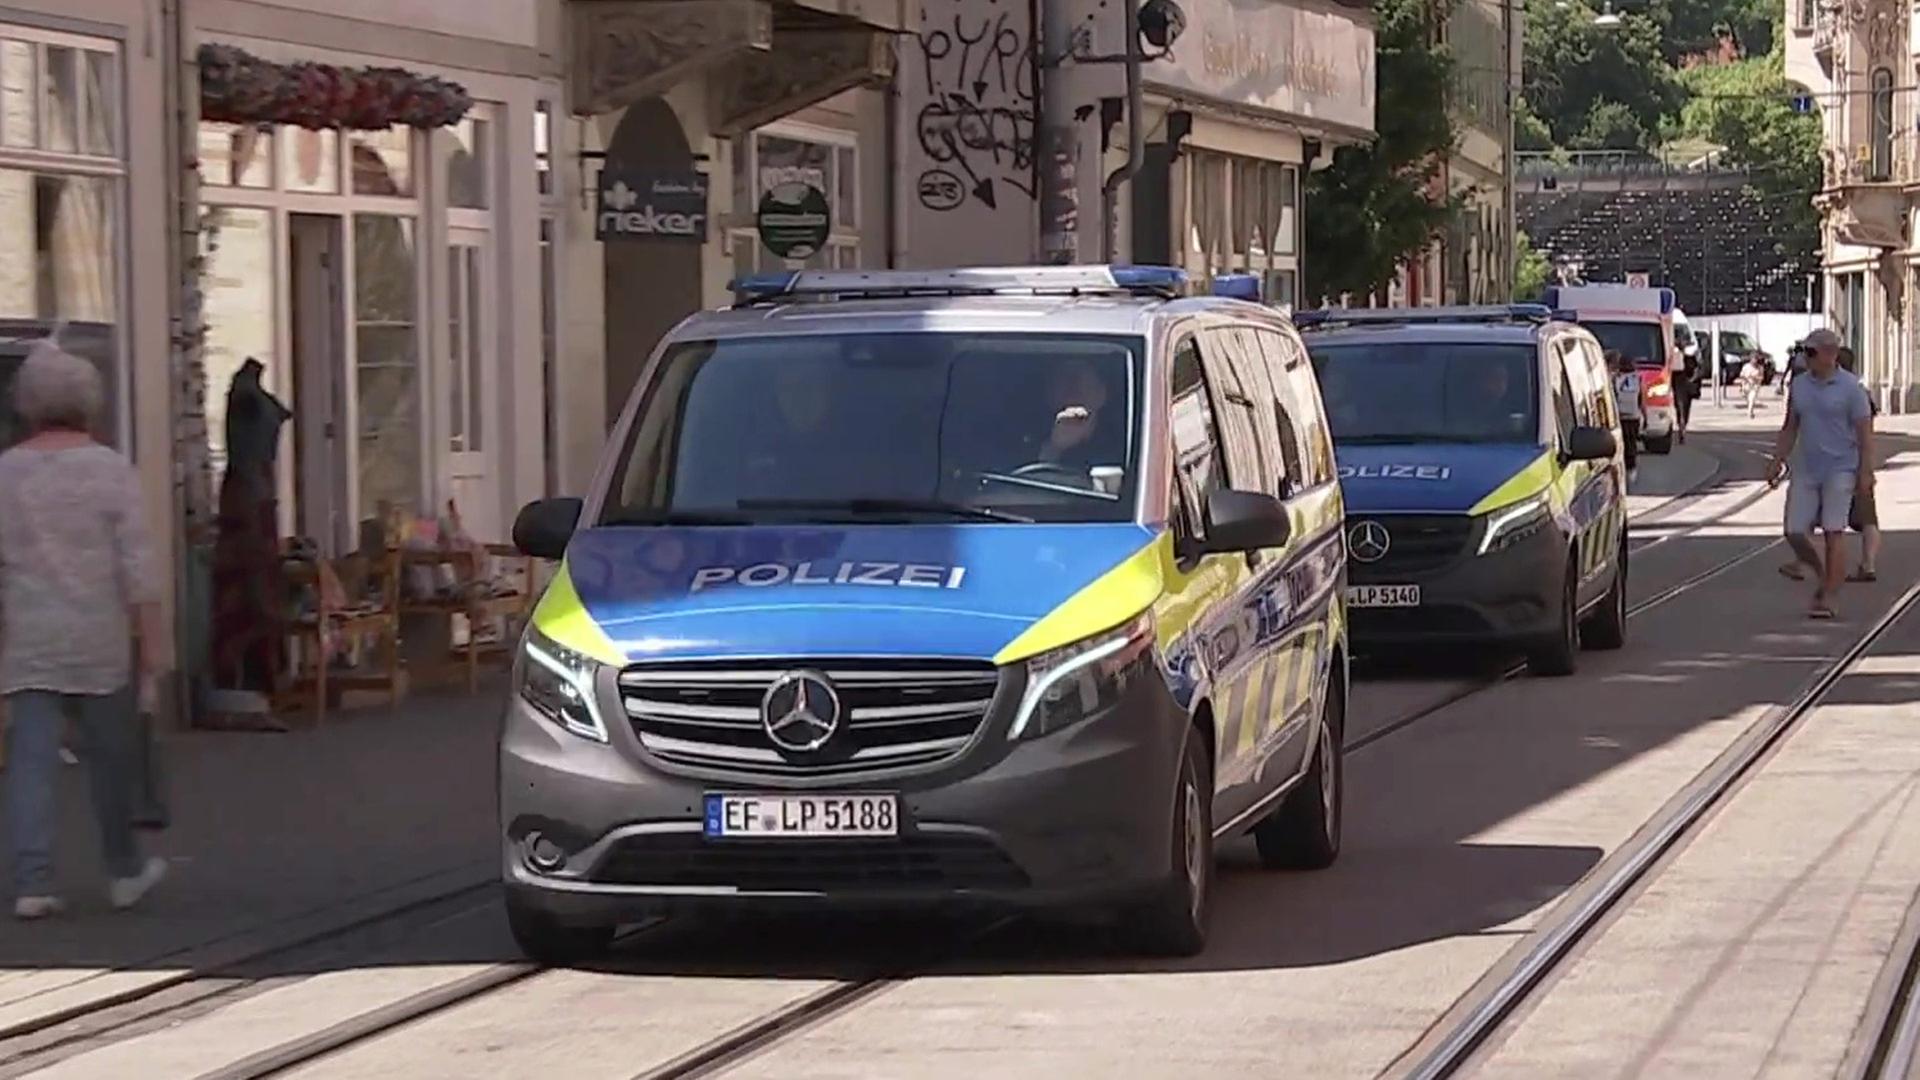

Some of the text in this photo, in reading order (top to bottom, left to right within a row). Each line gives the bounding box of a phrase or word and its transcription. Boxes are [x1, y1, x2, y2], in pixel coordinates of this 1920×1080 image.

[600, 204, 705, 234] rieker
[1339, 464, 1451, 479] OLIZEI
[689, 561, 967, 592] POLIZEI
[725, 800, 893, 831] EF LP 5188
